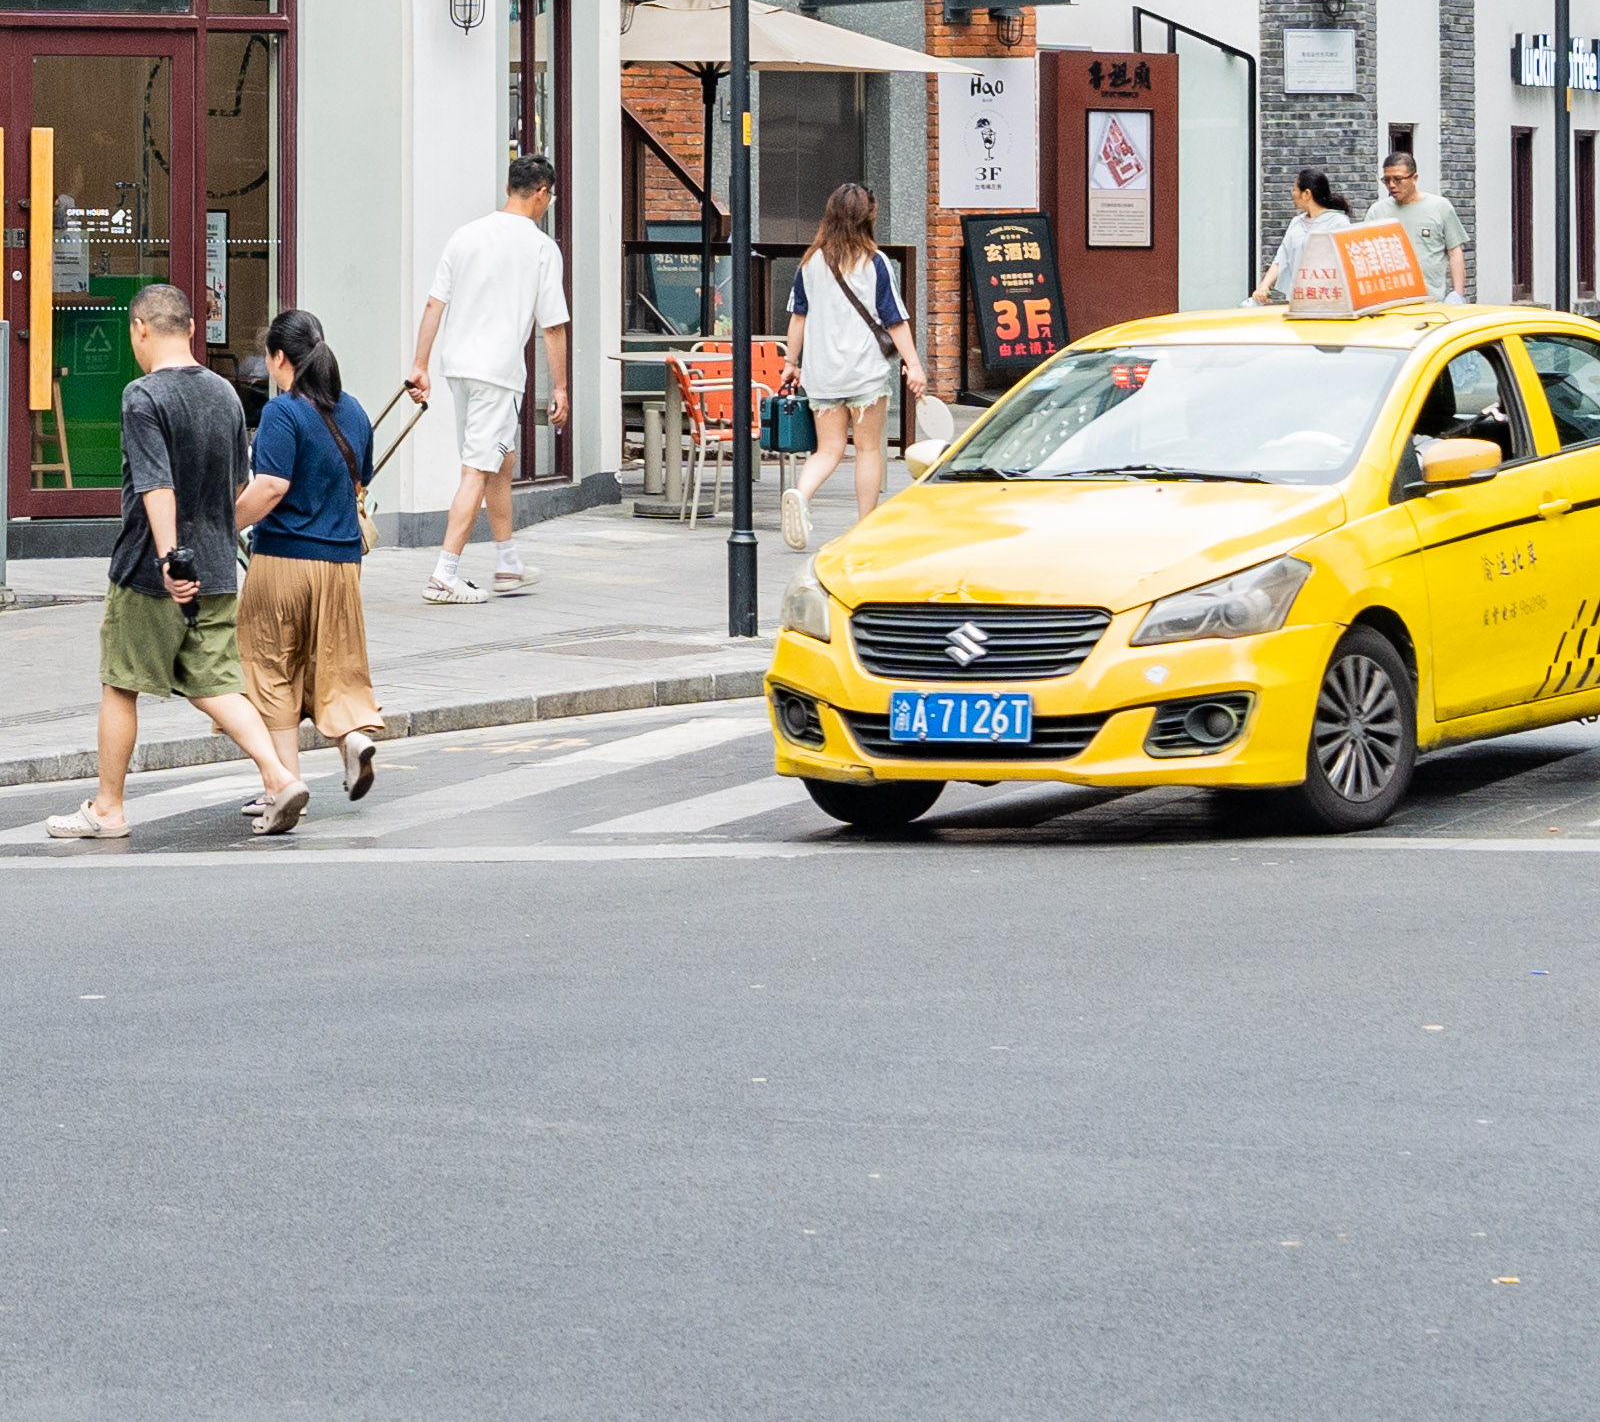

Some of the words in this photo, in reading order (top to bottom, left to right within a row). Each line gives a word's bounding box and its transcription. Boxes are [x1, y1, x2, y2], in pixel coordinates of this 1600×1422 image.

[974, 166, 1003, 182] 3F
[67, 208, 85, 216] OPEN
[86, 208, 109, 216] HOURS
[984, 241, 1042, 262] 玄酒场
[1300, 268, 1337, 279] TAXI
[1293, 286, 1344, 300] 出租汽车
[993, 298, 1052, 340] 3F
[999, 341, 1057, 357] 由此请上
